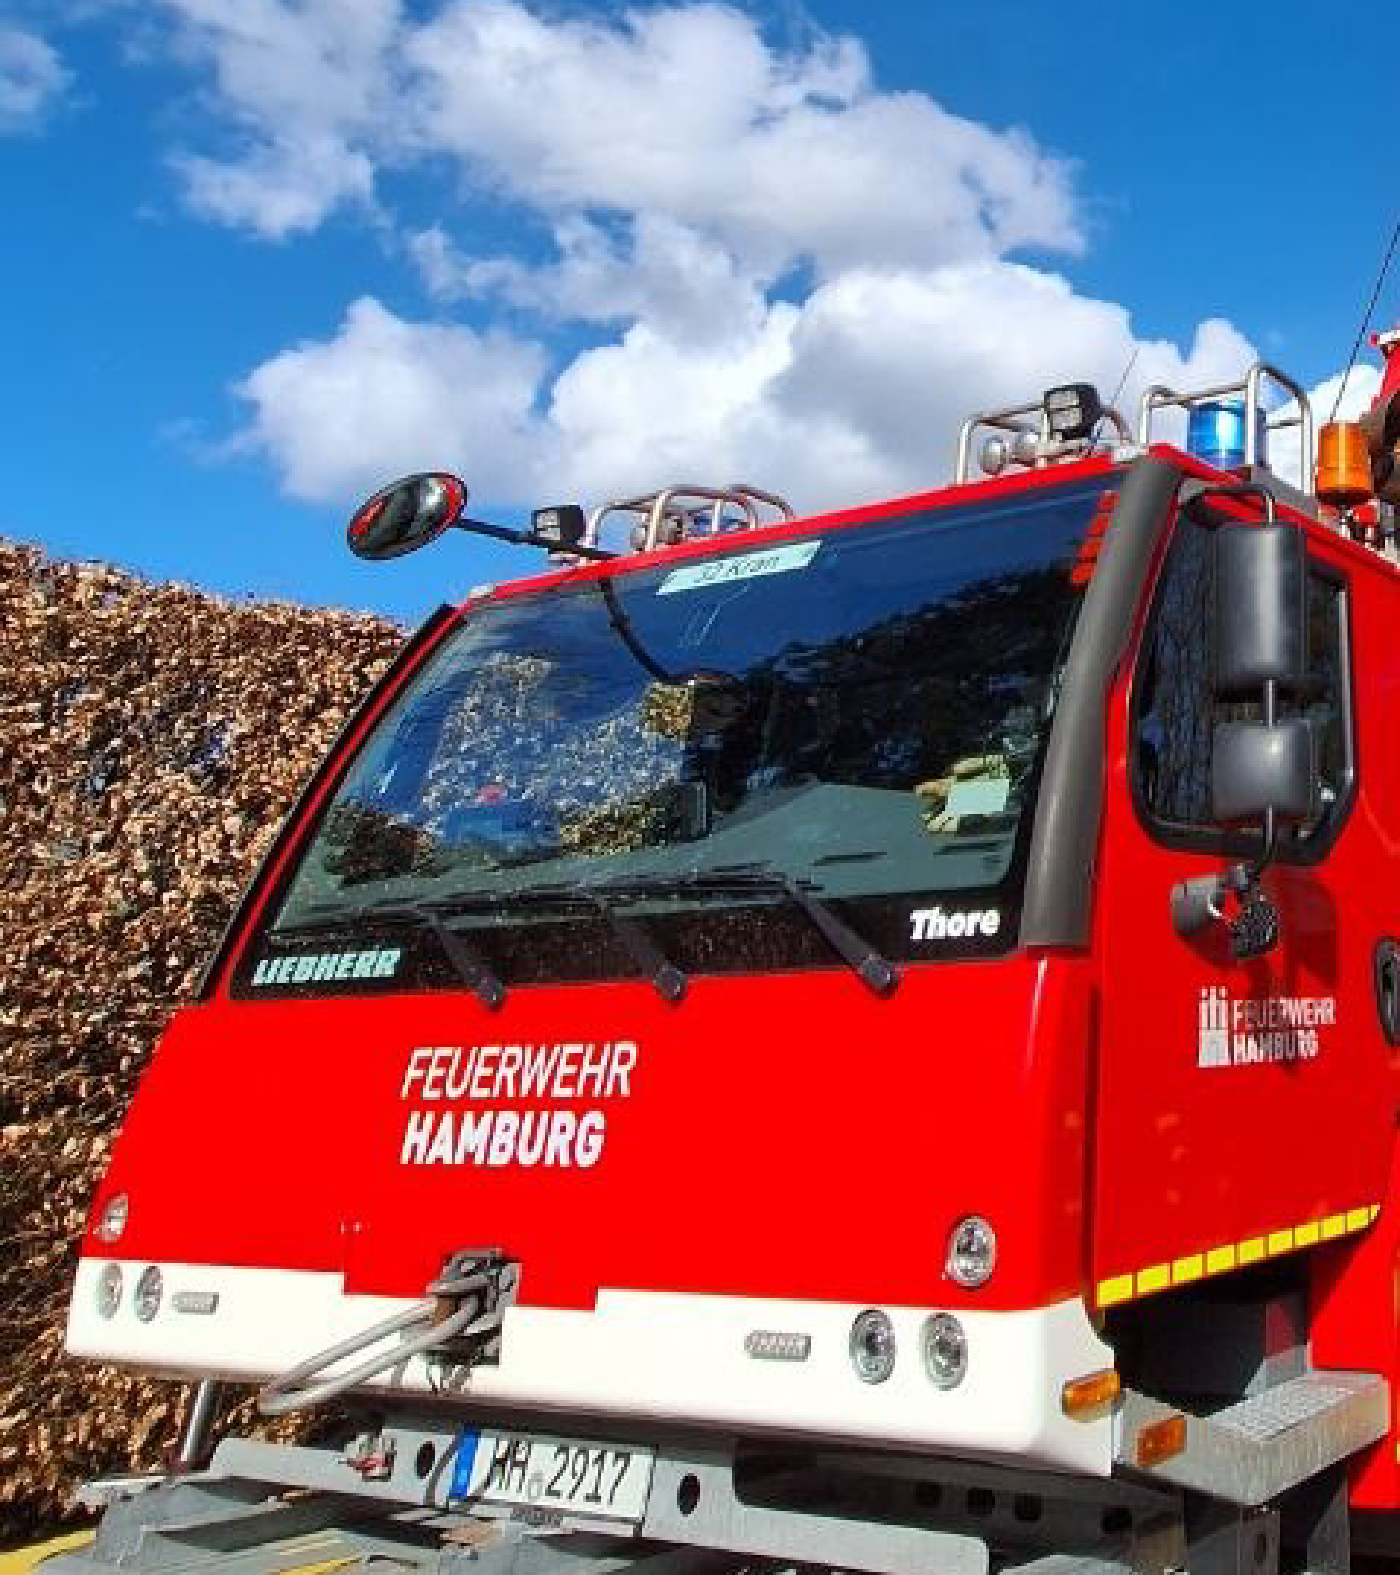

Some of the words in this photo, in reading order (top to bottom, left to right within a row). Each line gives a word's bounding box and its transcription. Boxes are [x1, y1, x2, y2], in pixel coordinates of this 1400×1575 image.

[909, 906, 1000, 940] Thore
[252, 949, 401, 986] LIEBHERR
[1232, 997, 1337, 1031] FEUERWEHR
[1232, 1029, 1319, 1065] HAMBURG
[402, 1042, 637, 1100] FEUERWEHR
[402, 1111, 605, 1167] HAMBURG
[545, 1446, 631, 1505] 2917
